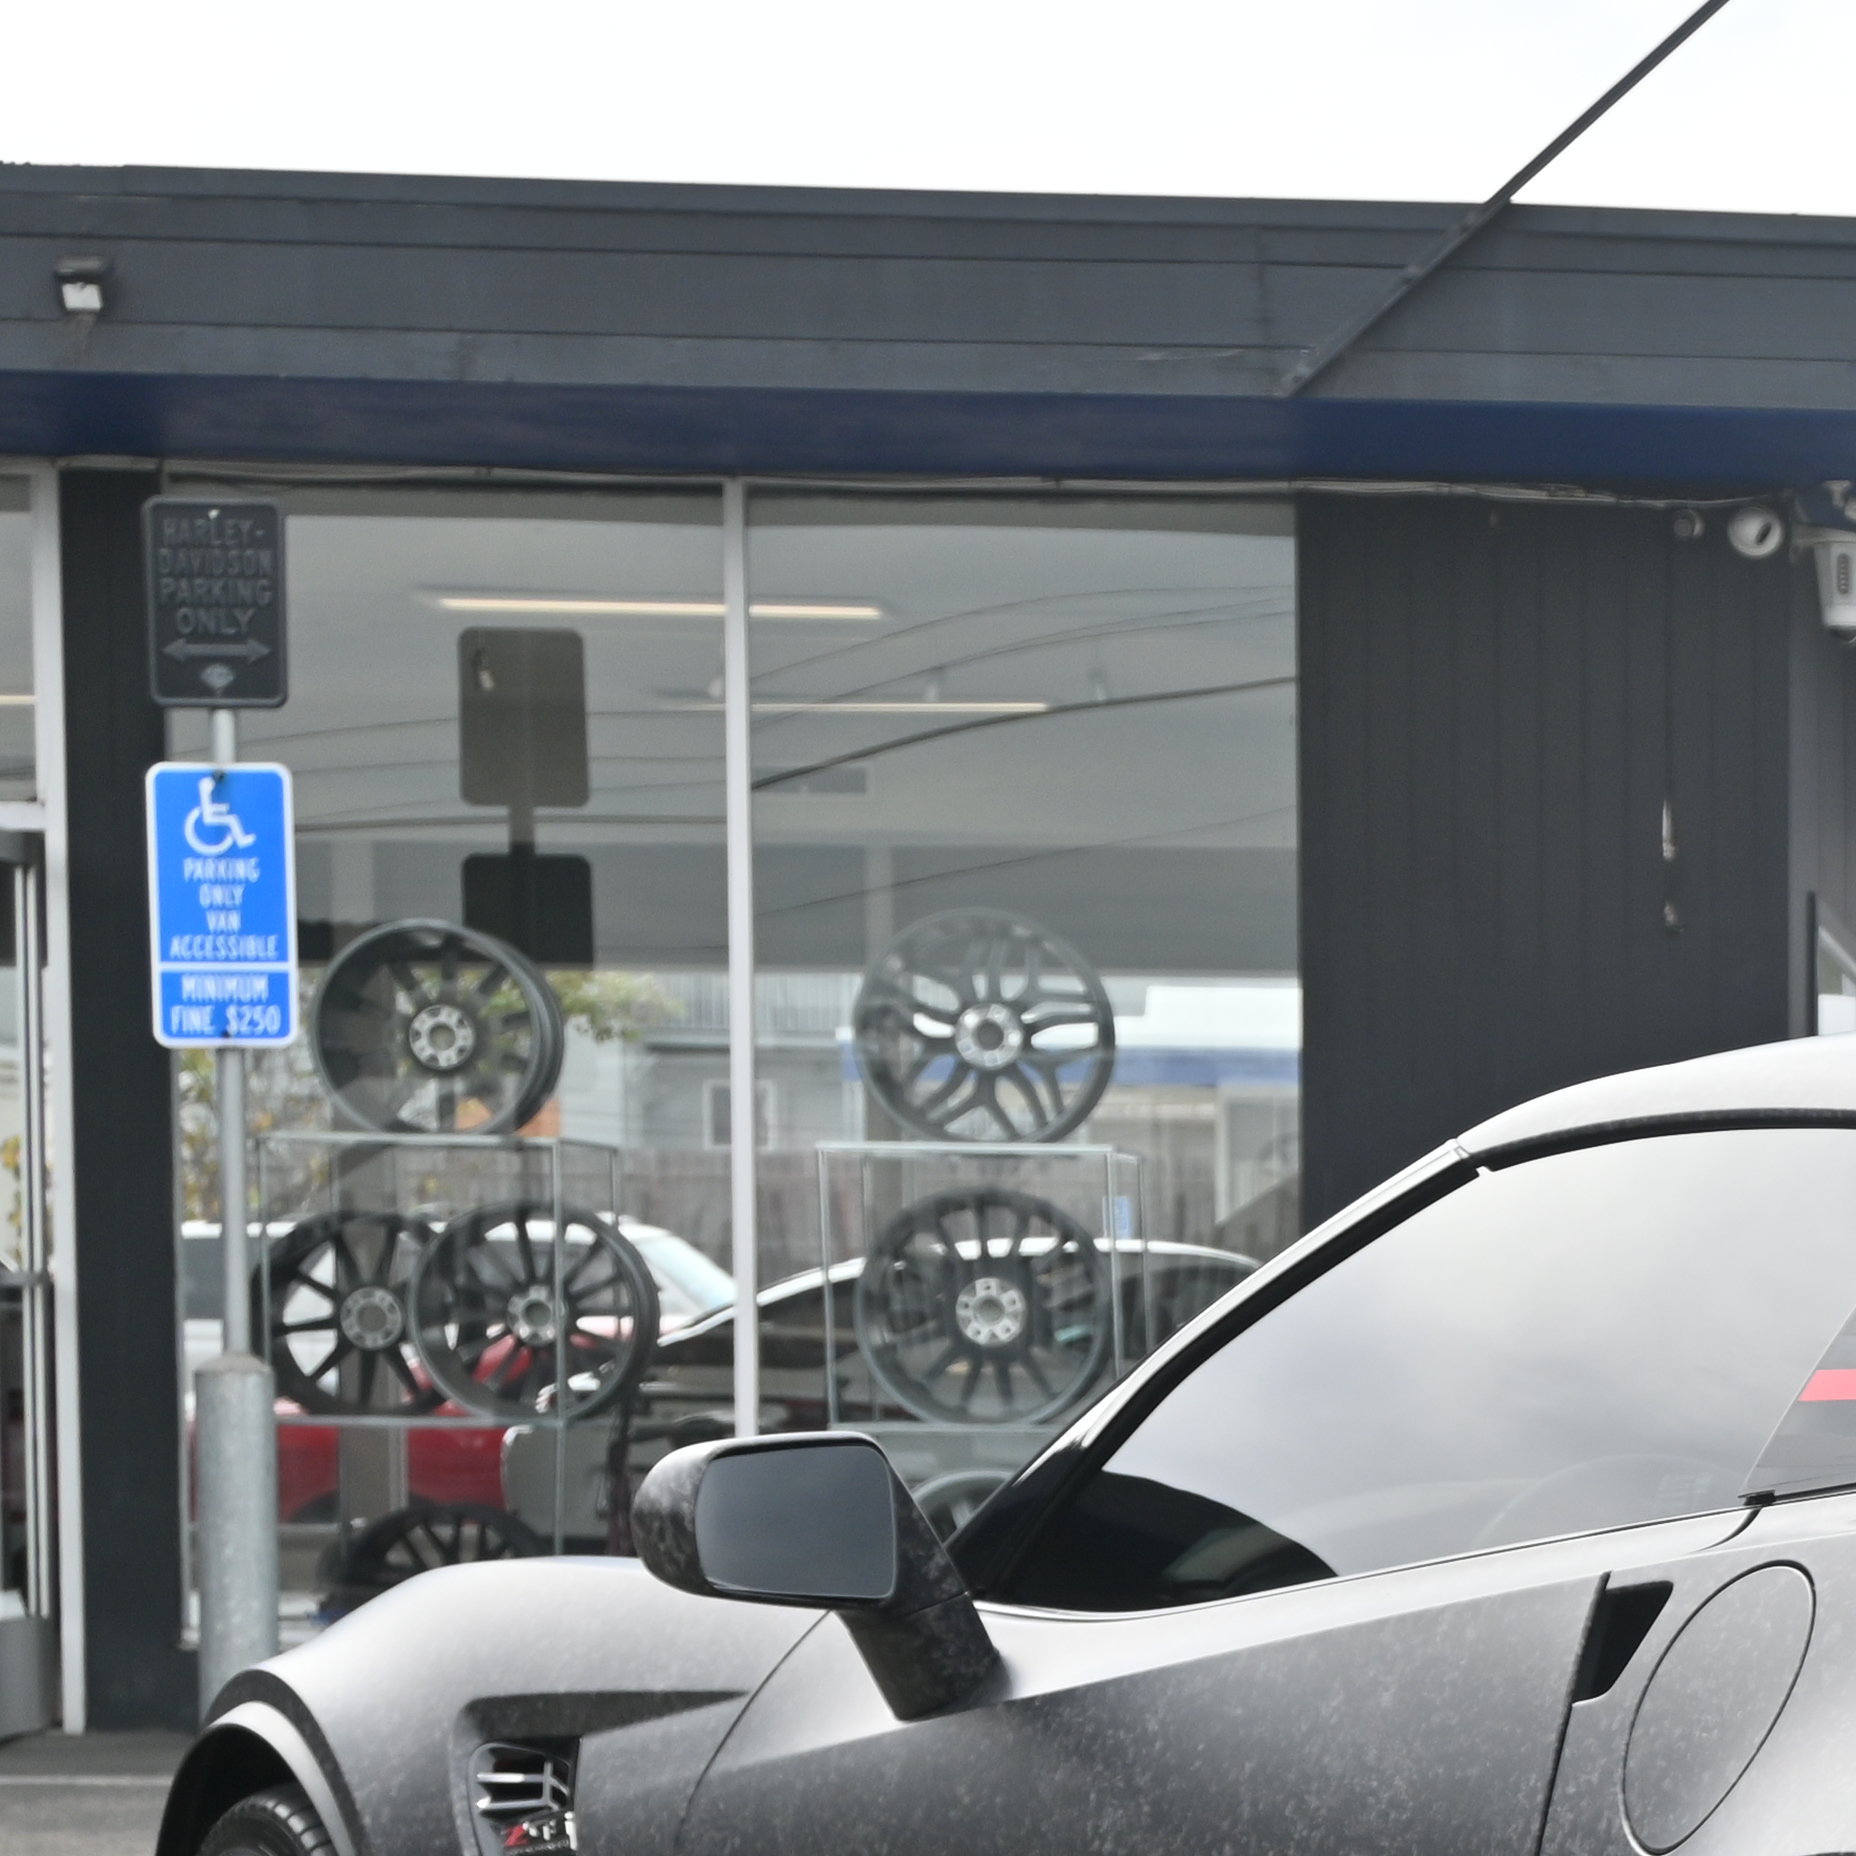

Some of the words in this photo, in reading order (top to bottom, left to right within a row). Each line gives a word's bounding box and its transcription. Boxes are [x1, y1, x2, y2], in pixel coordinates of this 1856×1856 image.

[163, 518, 266, 545] HARLEY-
[158, 548, 273, 575] DAVIDSON
[159, 577, 273, 606] PARKING
[176, 607, 256, 635] ONLY
[183, 857, 261, 883] PARKING
[200, 883, 245, 908] ONLY
[206, 909, 241, 934] VAN
[170, 934, 279, 960] ACCESSIBLE
[182, 973, 269, 1002] MINIMUM
[171, 1005, 215, 1035] FINE
[225, 1003, 281, 1036] $250
